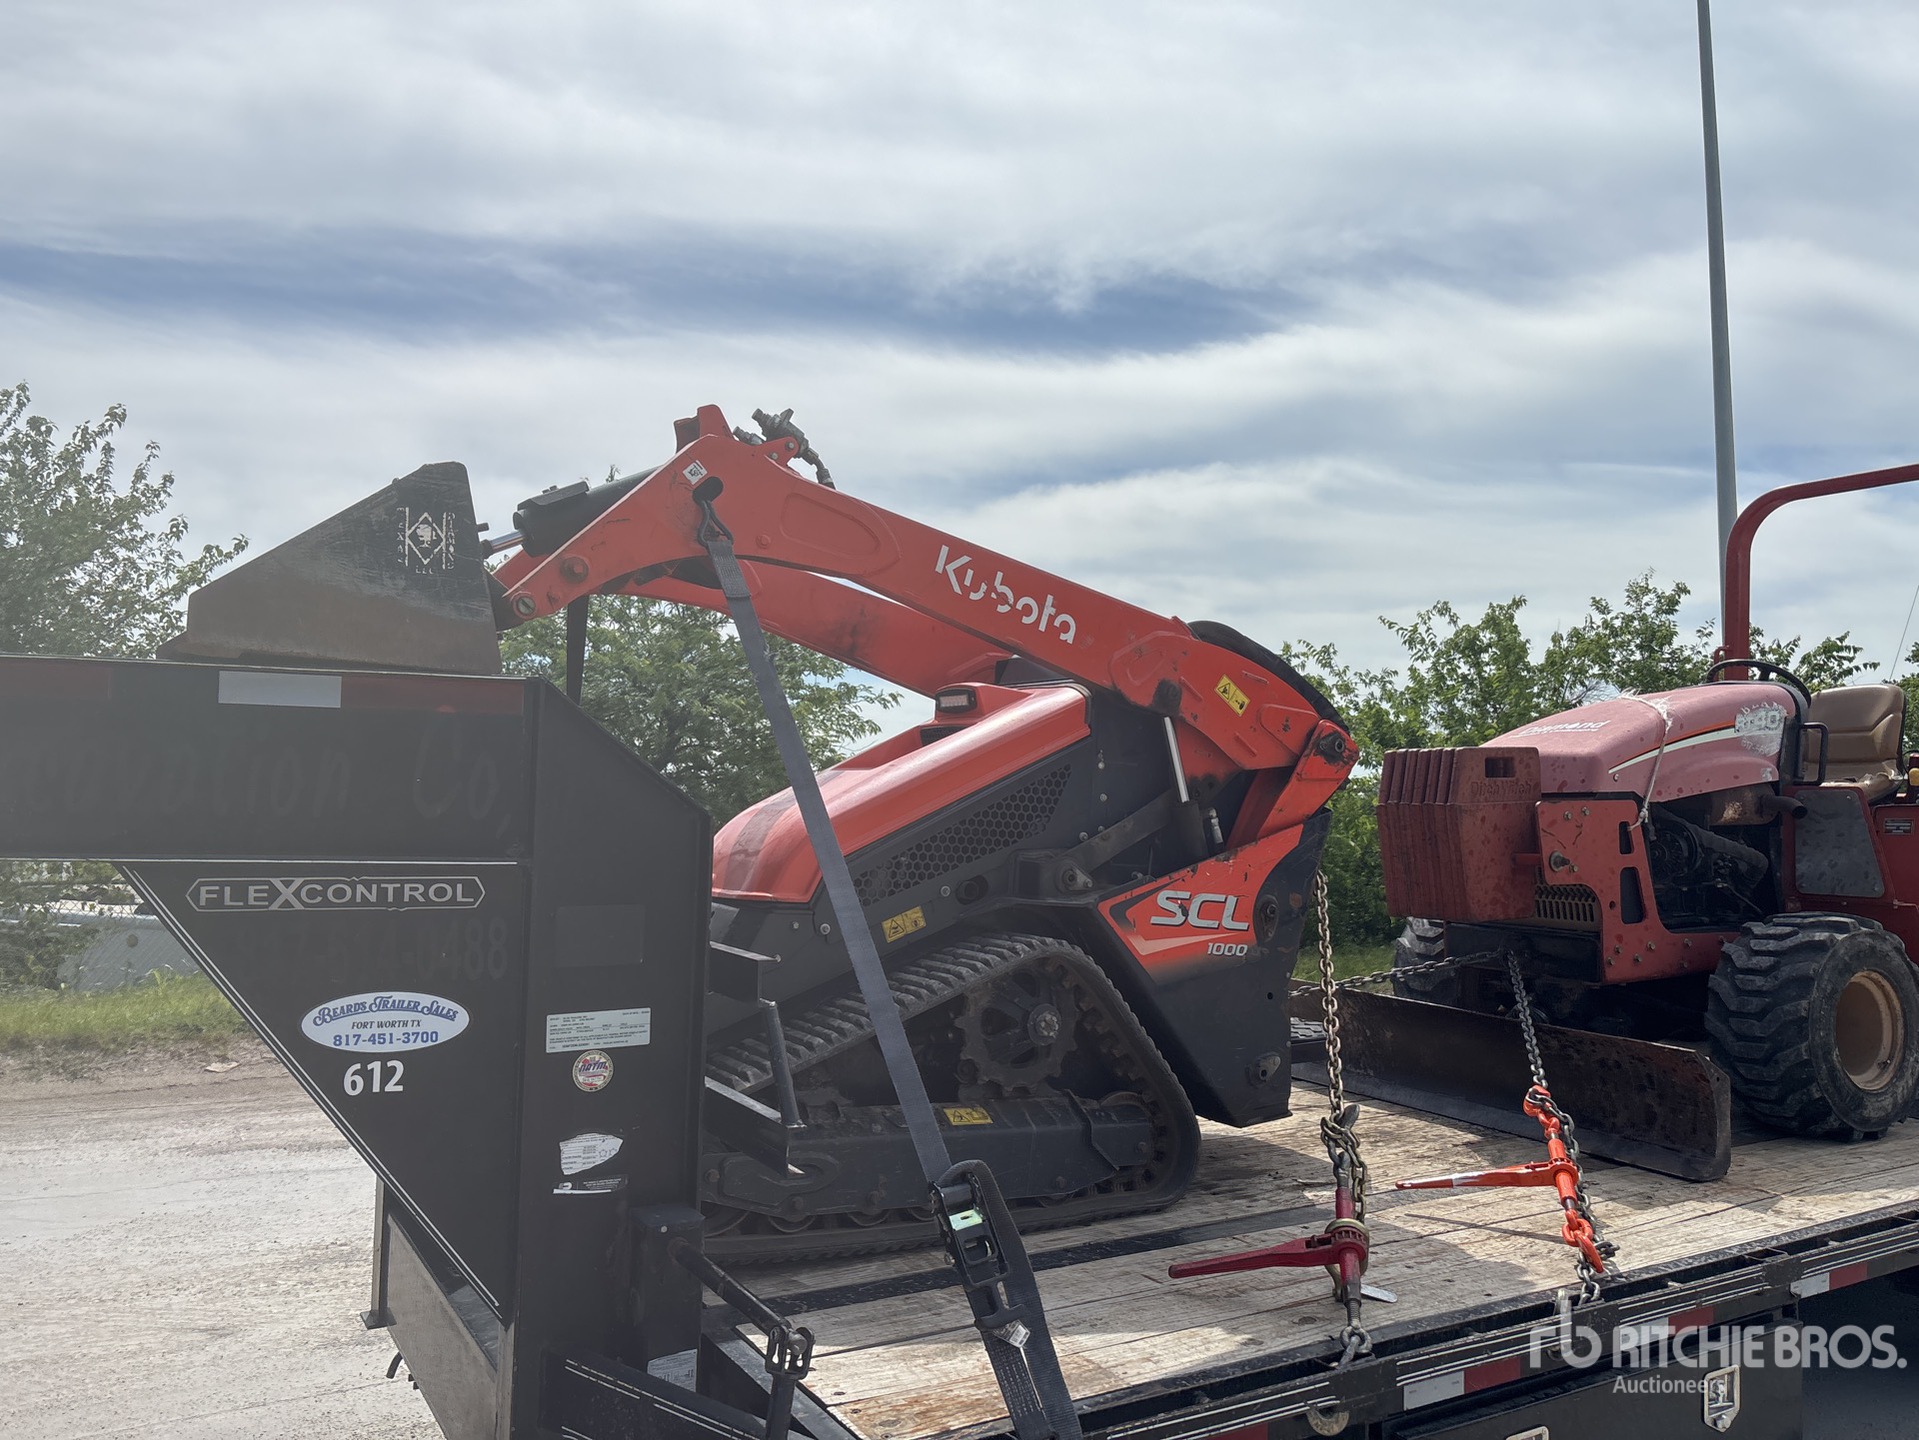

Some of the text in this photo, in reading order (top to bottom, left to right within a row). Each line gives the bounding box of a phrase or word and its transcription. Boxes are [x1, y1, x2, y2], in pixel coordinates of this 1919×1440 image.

[935, 545, 1077, 644] Kubota
[199, 878, 474, 910] FLEXCONTROL
[1150, 890, 1249, 931] SCL
[1207, 942, 1248, 957] 1000
[368, 995, 421, 1012] TRAILER
[421, 1000, 459, 1022] SALES
[333, 1031, 439, 1047] 817-451-3700
[351, 1019, 422, 1030] FORT WORTH TX
[343, 1060, 405, 1096] 612
